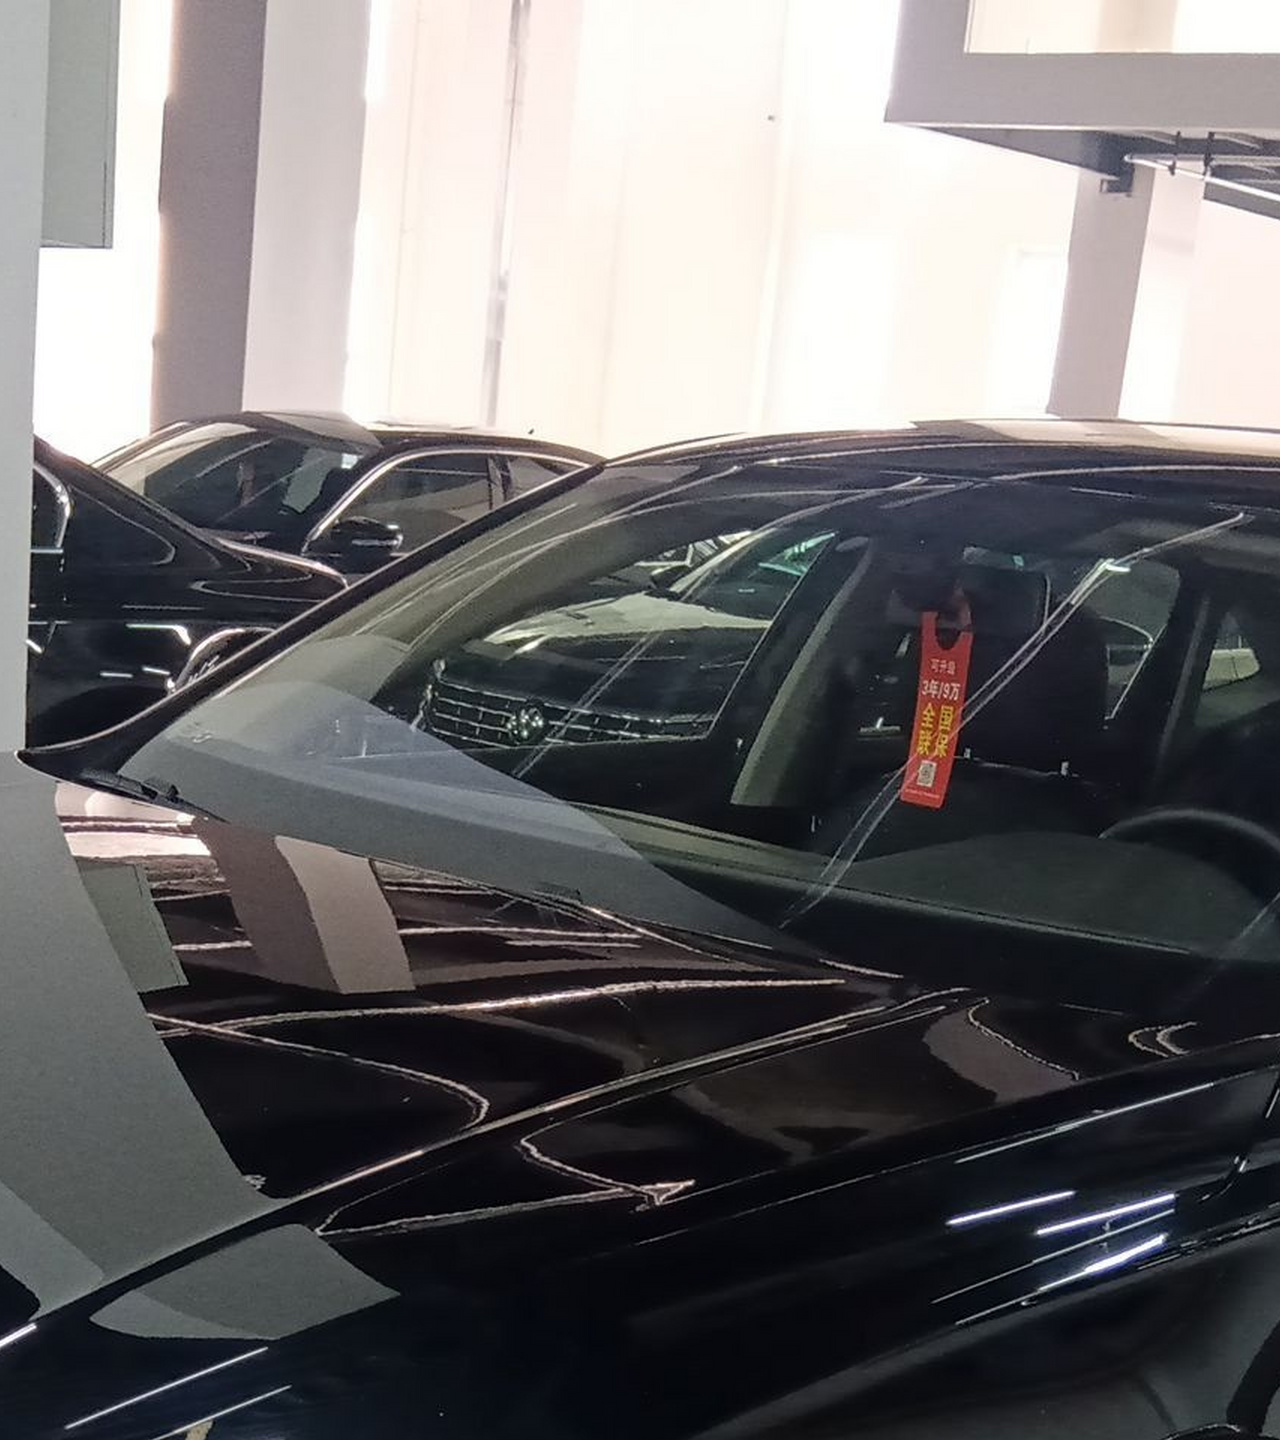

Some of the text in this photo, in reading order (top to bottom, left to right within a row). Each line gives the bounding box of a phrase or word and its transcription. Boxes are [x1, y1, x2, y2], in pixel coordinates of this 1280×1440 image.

[922, 680, 961, 701] 3年/9万
[921, 702, 954, 731] 全国
[917, 730, 949, 757] 联保
